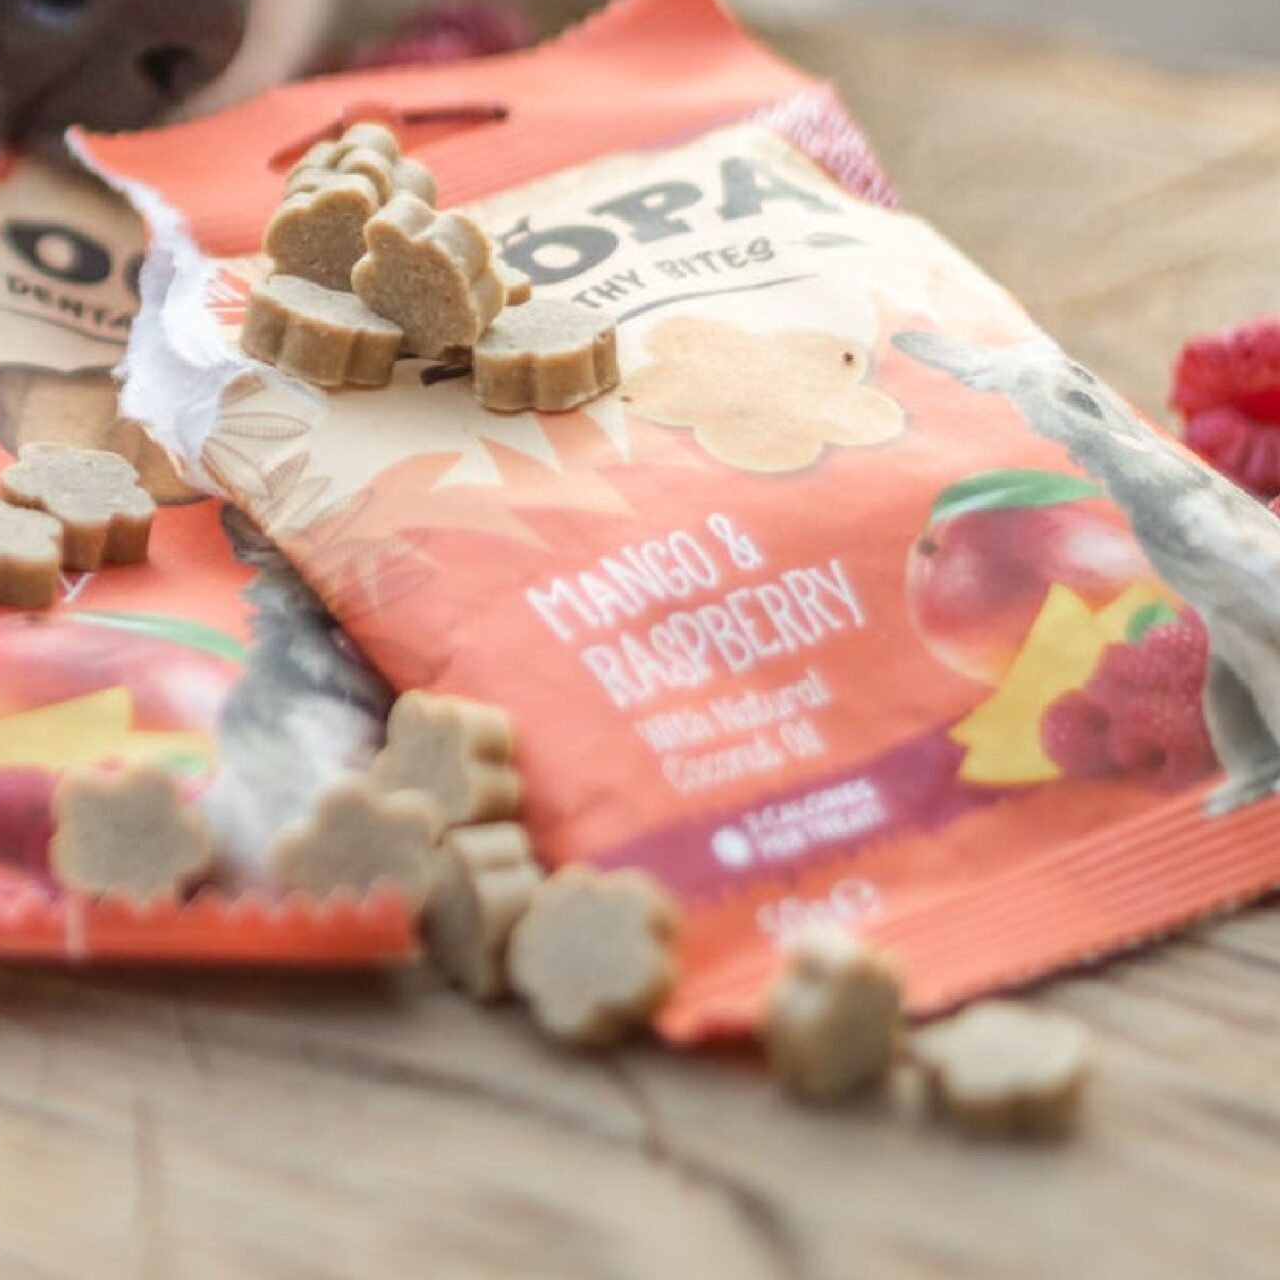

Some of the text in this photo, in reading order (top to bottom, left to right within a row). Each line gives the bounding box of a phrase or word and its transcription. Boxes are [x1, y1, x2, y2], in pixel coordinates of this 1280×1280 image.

[654, 236, 775, 280] BITES
[524, 511, 763, 643] MANGO &
[579, 557, 868, 710] RASPBERRY
